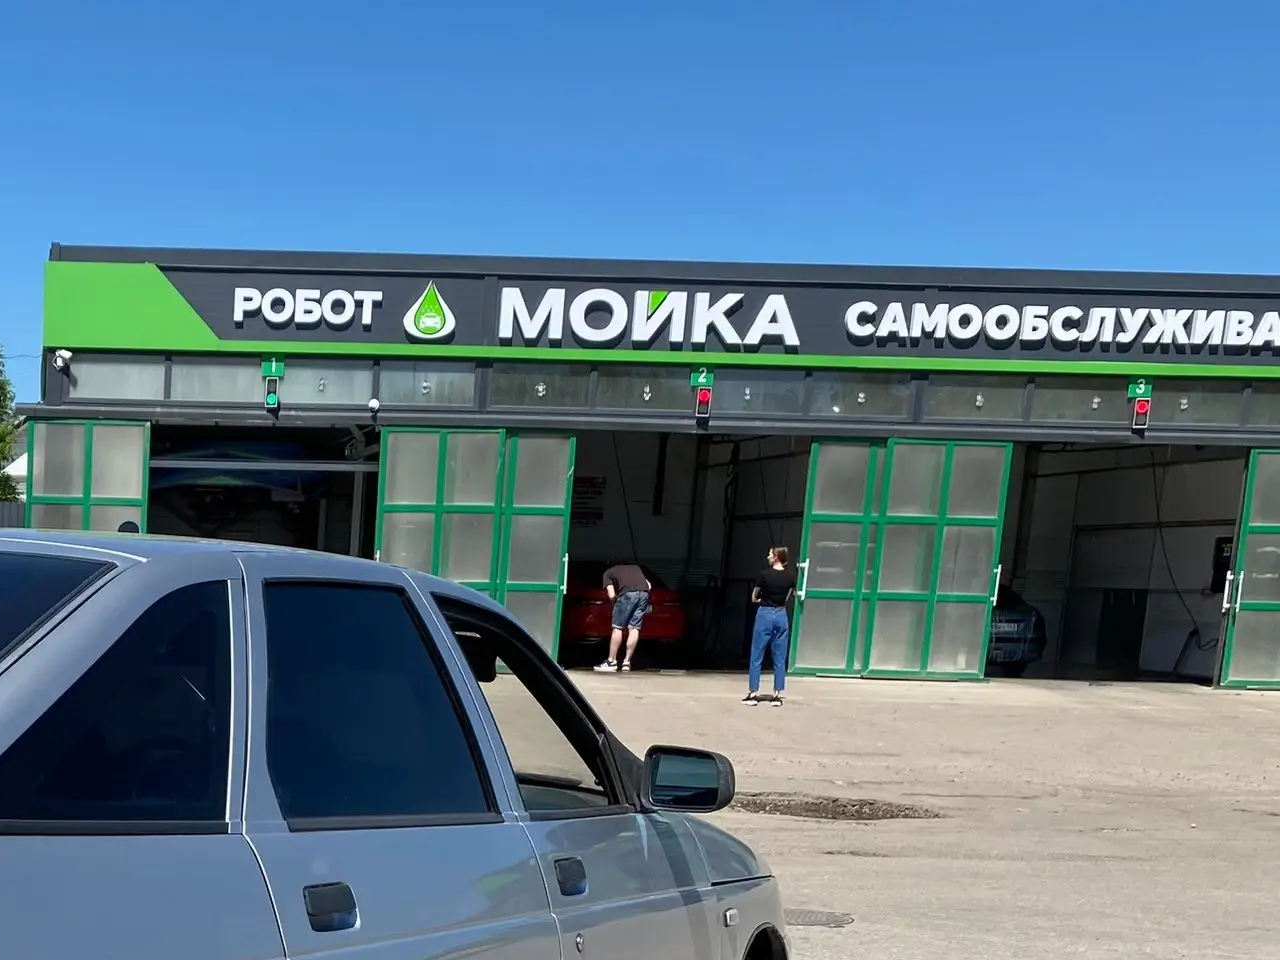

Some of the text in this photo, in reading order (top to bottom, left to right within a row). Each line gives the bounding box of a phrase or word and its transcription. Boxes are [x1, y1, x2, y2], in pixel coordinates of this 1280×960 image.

[233, 287, 383, 327] РОБОТ
[270, 356, 276, 373] 1
[697, 366, 708, 383] 2
[1135, 378, 1146, 394] 3
